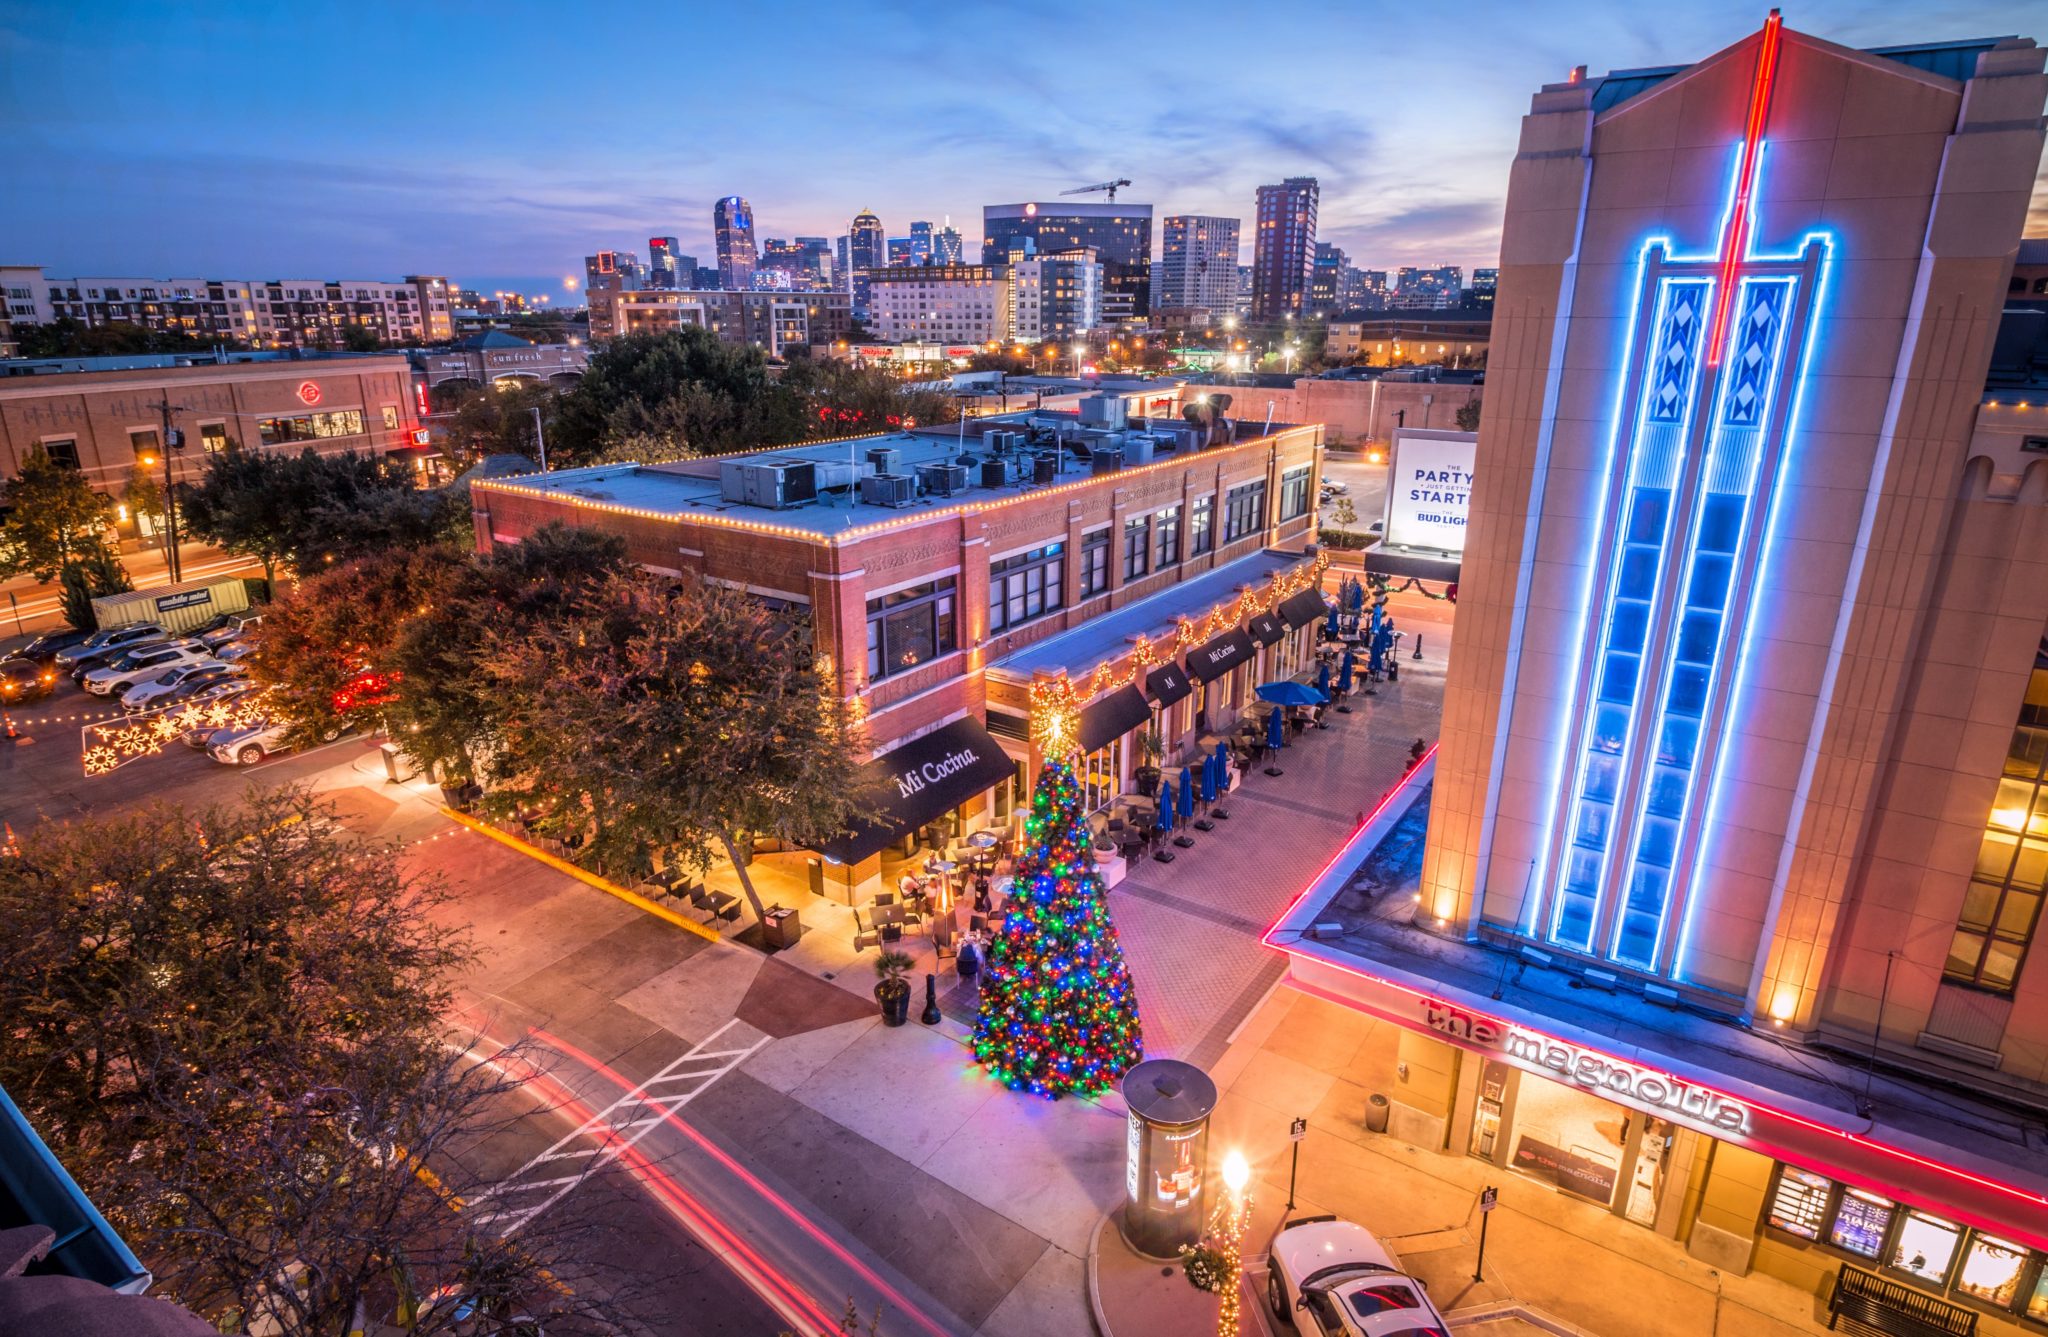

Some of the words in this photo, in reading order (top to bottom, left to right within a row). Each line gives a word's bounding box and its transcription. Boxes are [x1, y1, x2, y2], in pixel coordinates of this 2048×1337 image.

[493, 354, 511, 363] sun
[514, 351, 542, 361] fresh
[1415, 469, 1473, 485] PARTY
[1410, 489, 1470, 505] START
[1417, 513, 1441, 523] BUD
[159, 595, 188, 607] mobile
[189, 591, 207, 601] mini
[1263, 622, 1272, 632] M
[1164, 676, 1175, 689] M
[895, 769, 926, 799] Mi
[1421, 998, 1499, 1044] the
[1507, 1030, 1747, 1136] magnolia
[1537, 1155, 1558, 1169] the
[1558, 1164, 1612, 1189] magnolia
